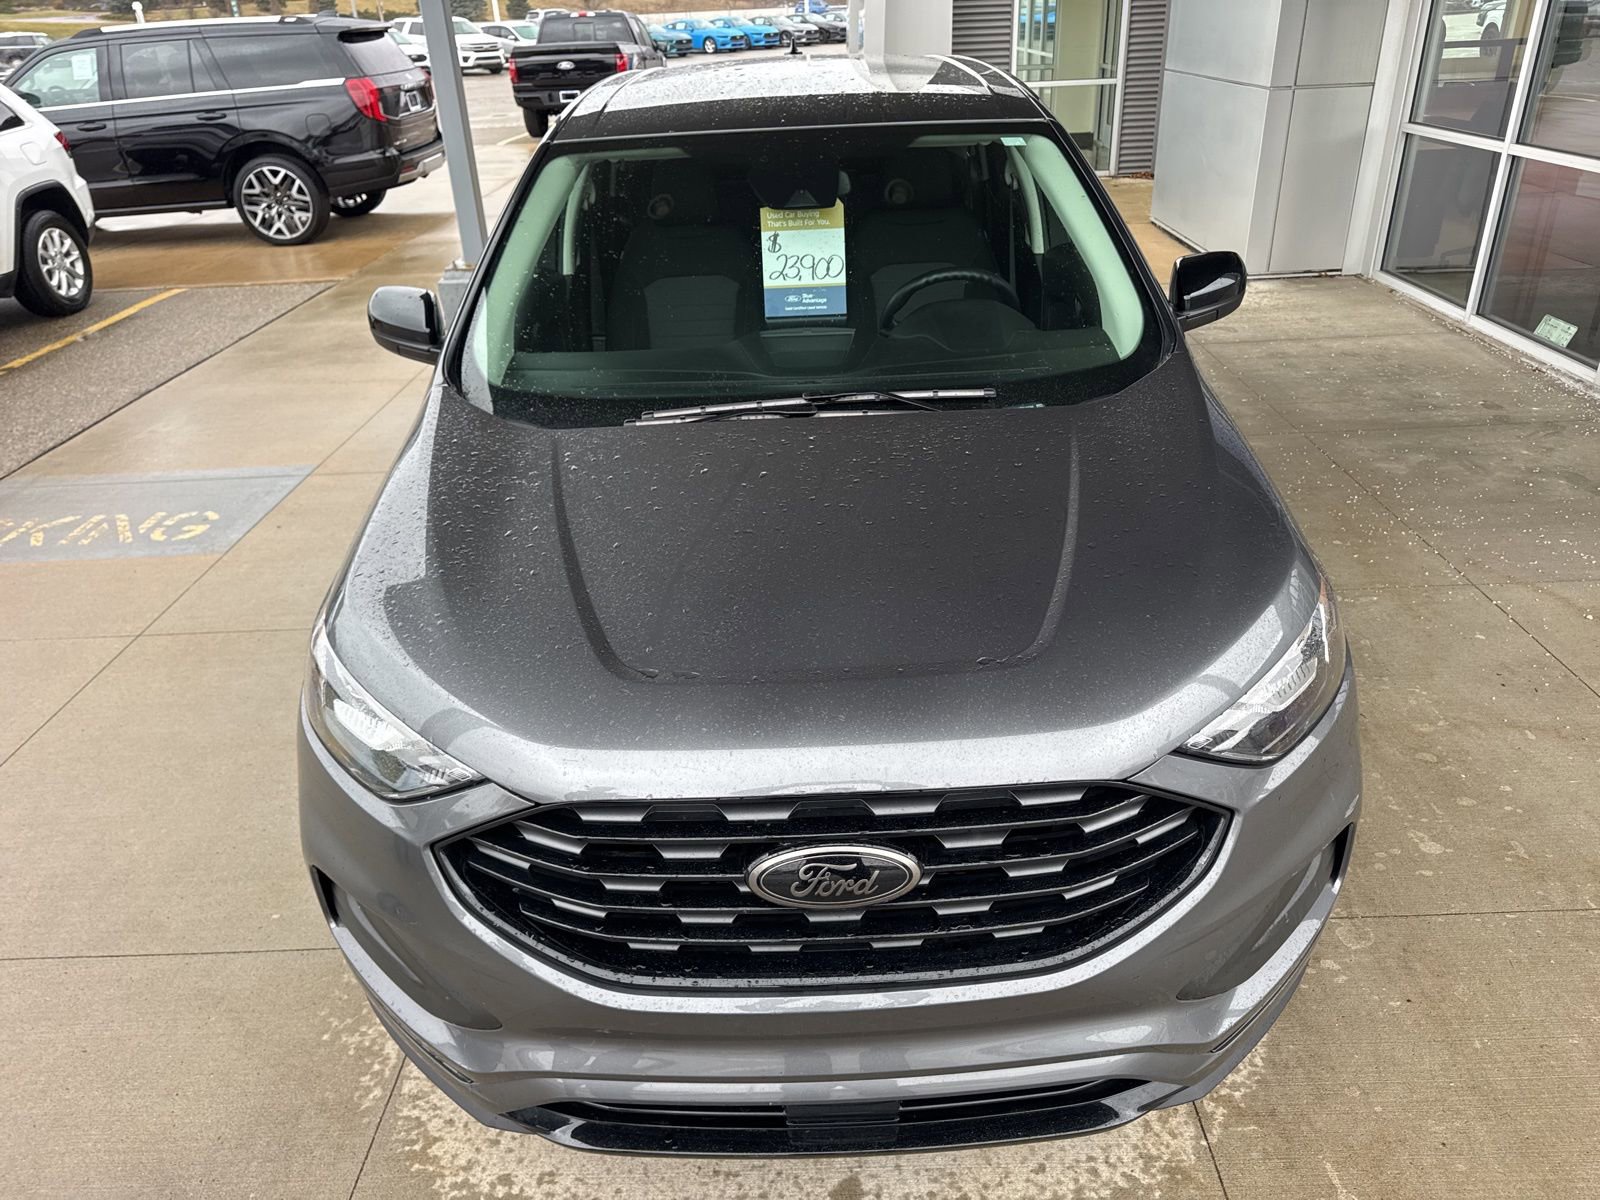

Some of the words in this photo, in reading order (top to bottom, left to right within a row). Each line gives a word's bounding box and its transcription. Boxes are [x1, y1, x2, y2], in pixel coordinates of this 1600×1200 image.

[766, 211, 784, 219] Used
[797, 210, 820, 219] Buying
[767, 220, 787, 228] That's
[767, 231, 782, 254] $
[769, 253, 845, 281] 23,900
[790, 862, 881, 898] Ford
